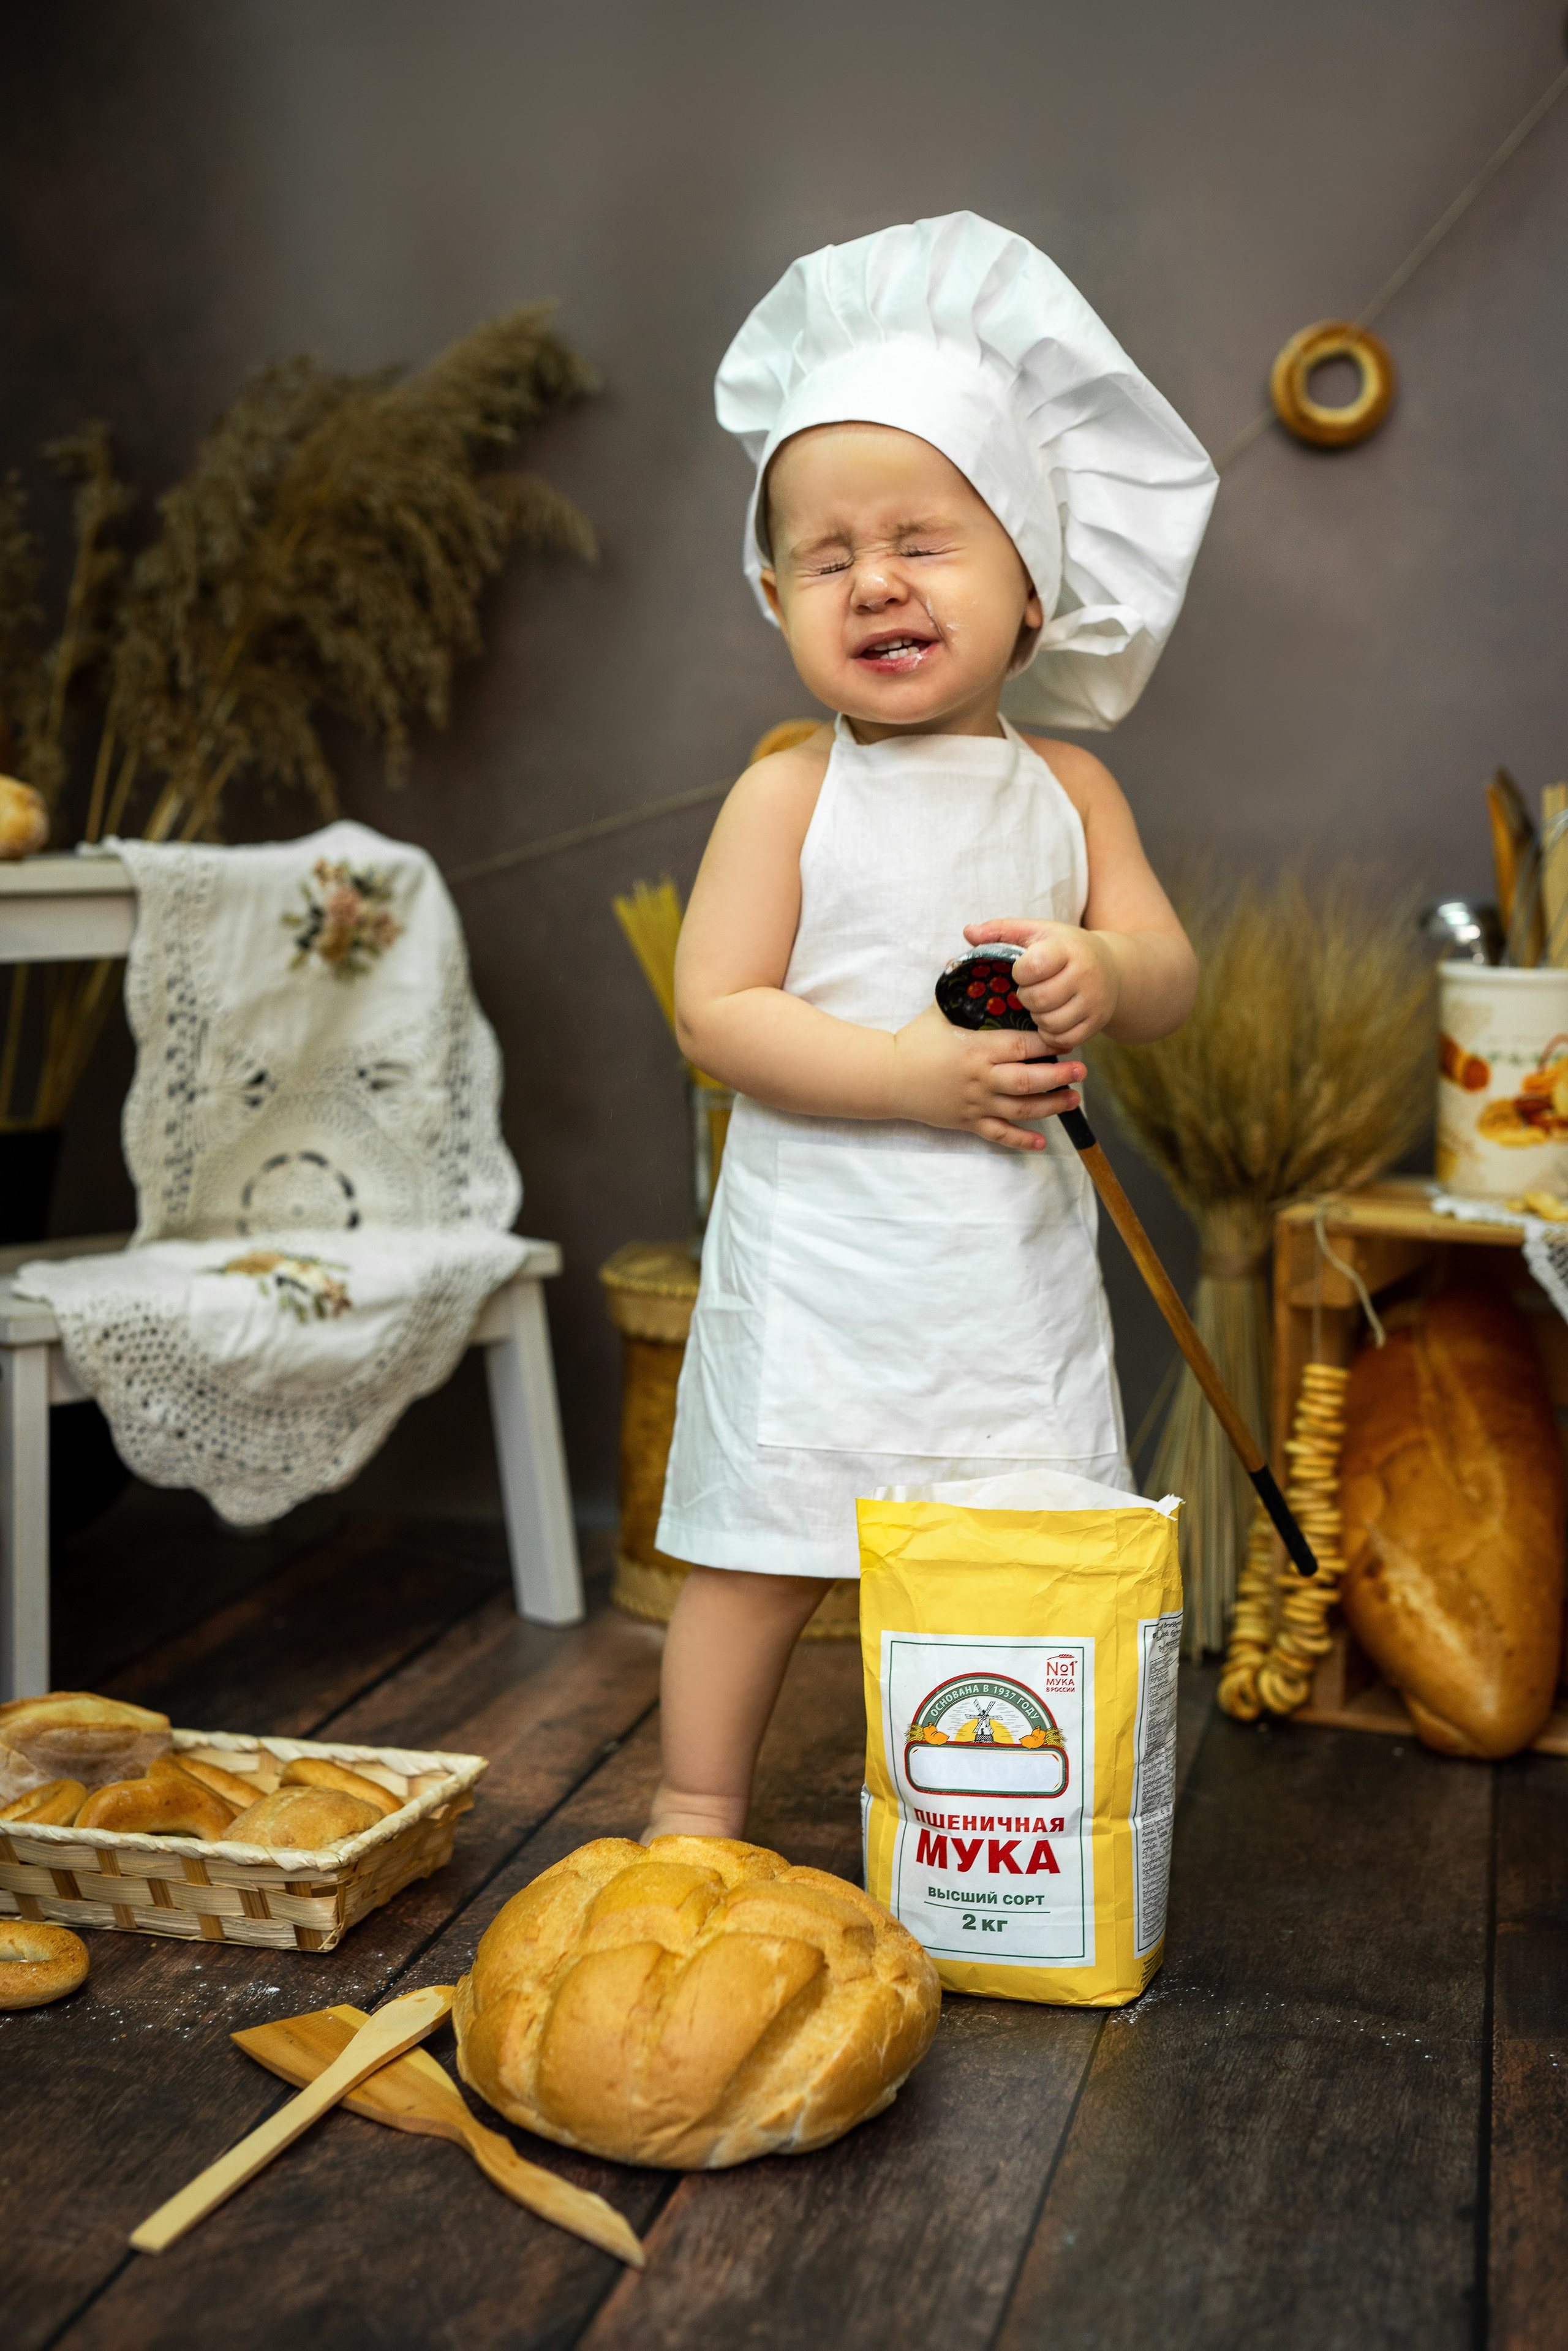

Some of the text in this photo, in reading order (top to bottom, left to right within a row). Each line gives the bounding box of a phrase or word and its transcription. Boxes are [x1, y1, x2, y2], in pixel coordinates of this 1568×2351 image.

[930, 1685, 980, 1717] ОСНОВАНА
[993, 1686, 1016, 1700] 1937
[1016, 1697, 1040, 1720] ГОДУ
[914, 1808, 1065, 1833] ПШЕНИЧНАЯ
[916, 1828, 1061, 1875] МУКА
[928, 1886, 1045, 1906] ВЫСШИЙ СОРТ
[962, 1914, 977, 1930] 2
